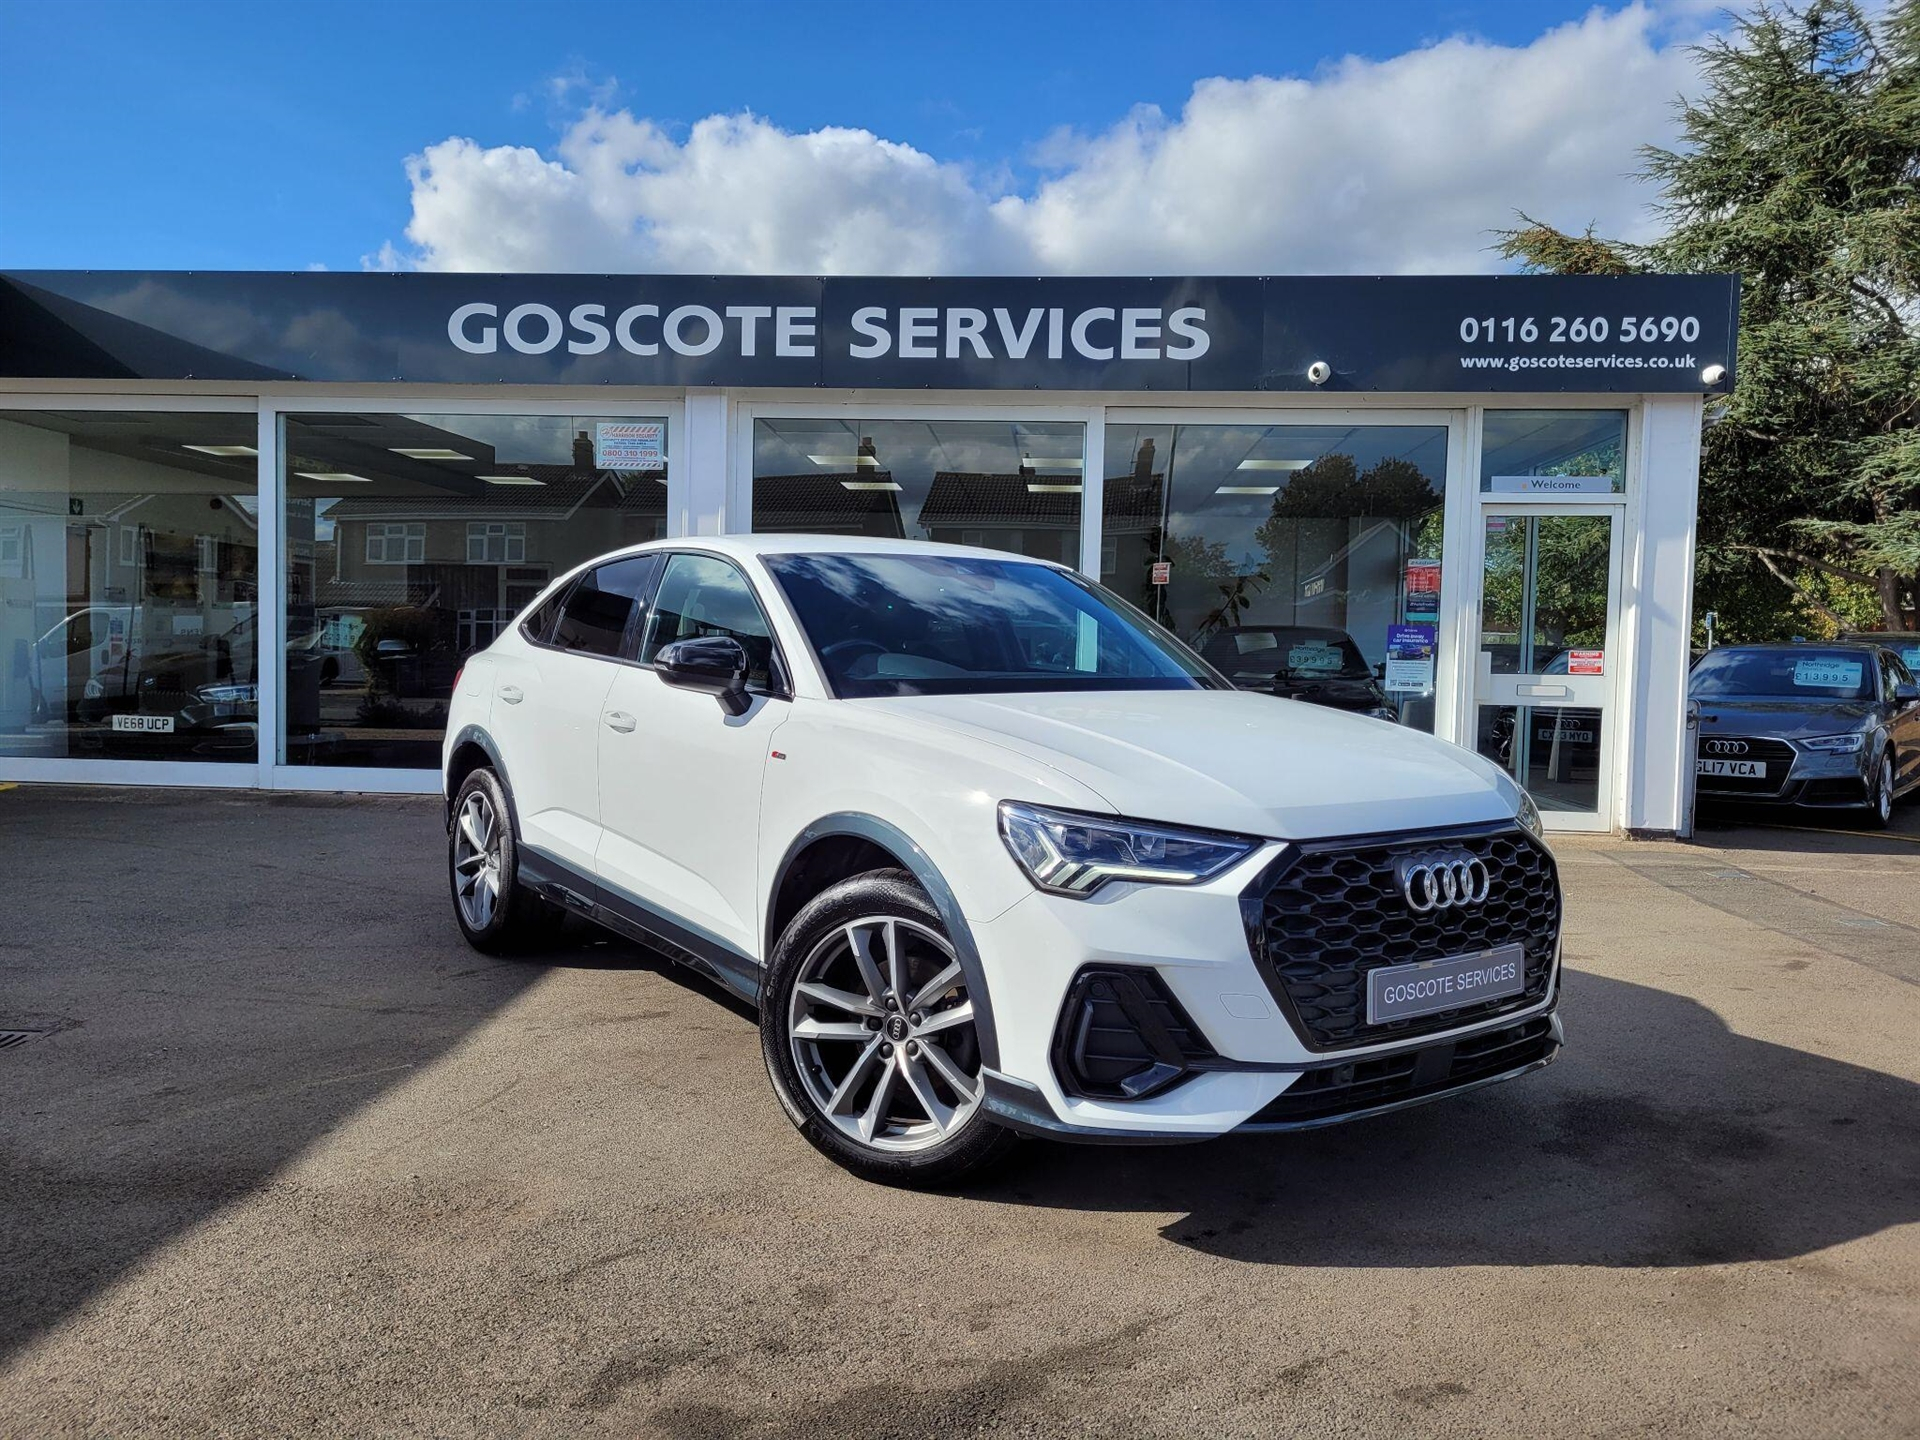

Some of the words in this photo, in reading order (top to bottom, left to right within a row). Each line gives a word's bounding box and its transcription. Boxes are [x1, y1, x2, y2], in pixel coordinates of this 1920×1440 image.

[447, 302, 816, 357] GOSCOTE
[849, 306, 1211, 361] SERVICES
[1460, 317, 1539, 343] 0116
[1549, 316, 1609, 343] 260
[1619, 316, 1700, 343] 5690
[1460, 353, 1696, 372] www.goscoteservices.co.uk
[639, 450, 658, 458] 1999
[1531, 480, 1581, 489] Welcome
[1795, 672, 1849, 682] £13995
[117, 717, 144, 729] VE68
[146, 718, 169, 730] UCP
[1542, 730, 1567, 740] CX3
[1696, 760, 1725, 774] GL17
[1729, 762, 1757, 776] VCA
[1384, 976, 1453, 1003] GOSCOTE
[1456, 963, 1516, 990] SERVICES
